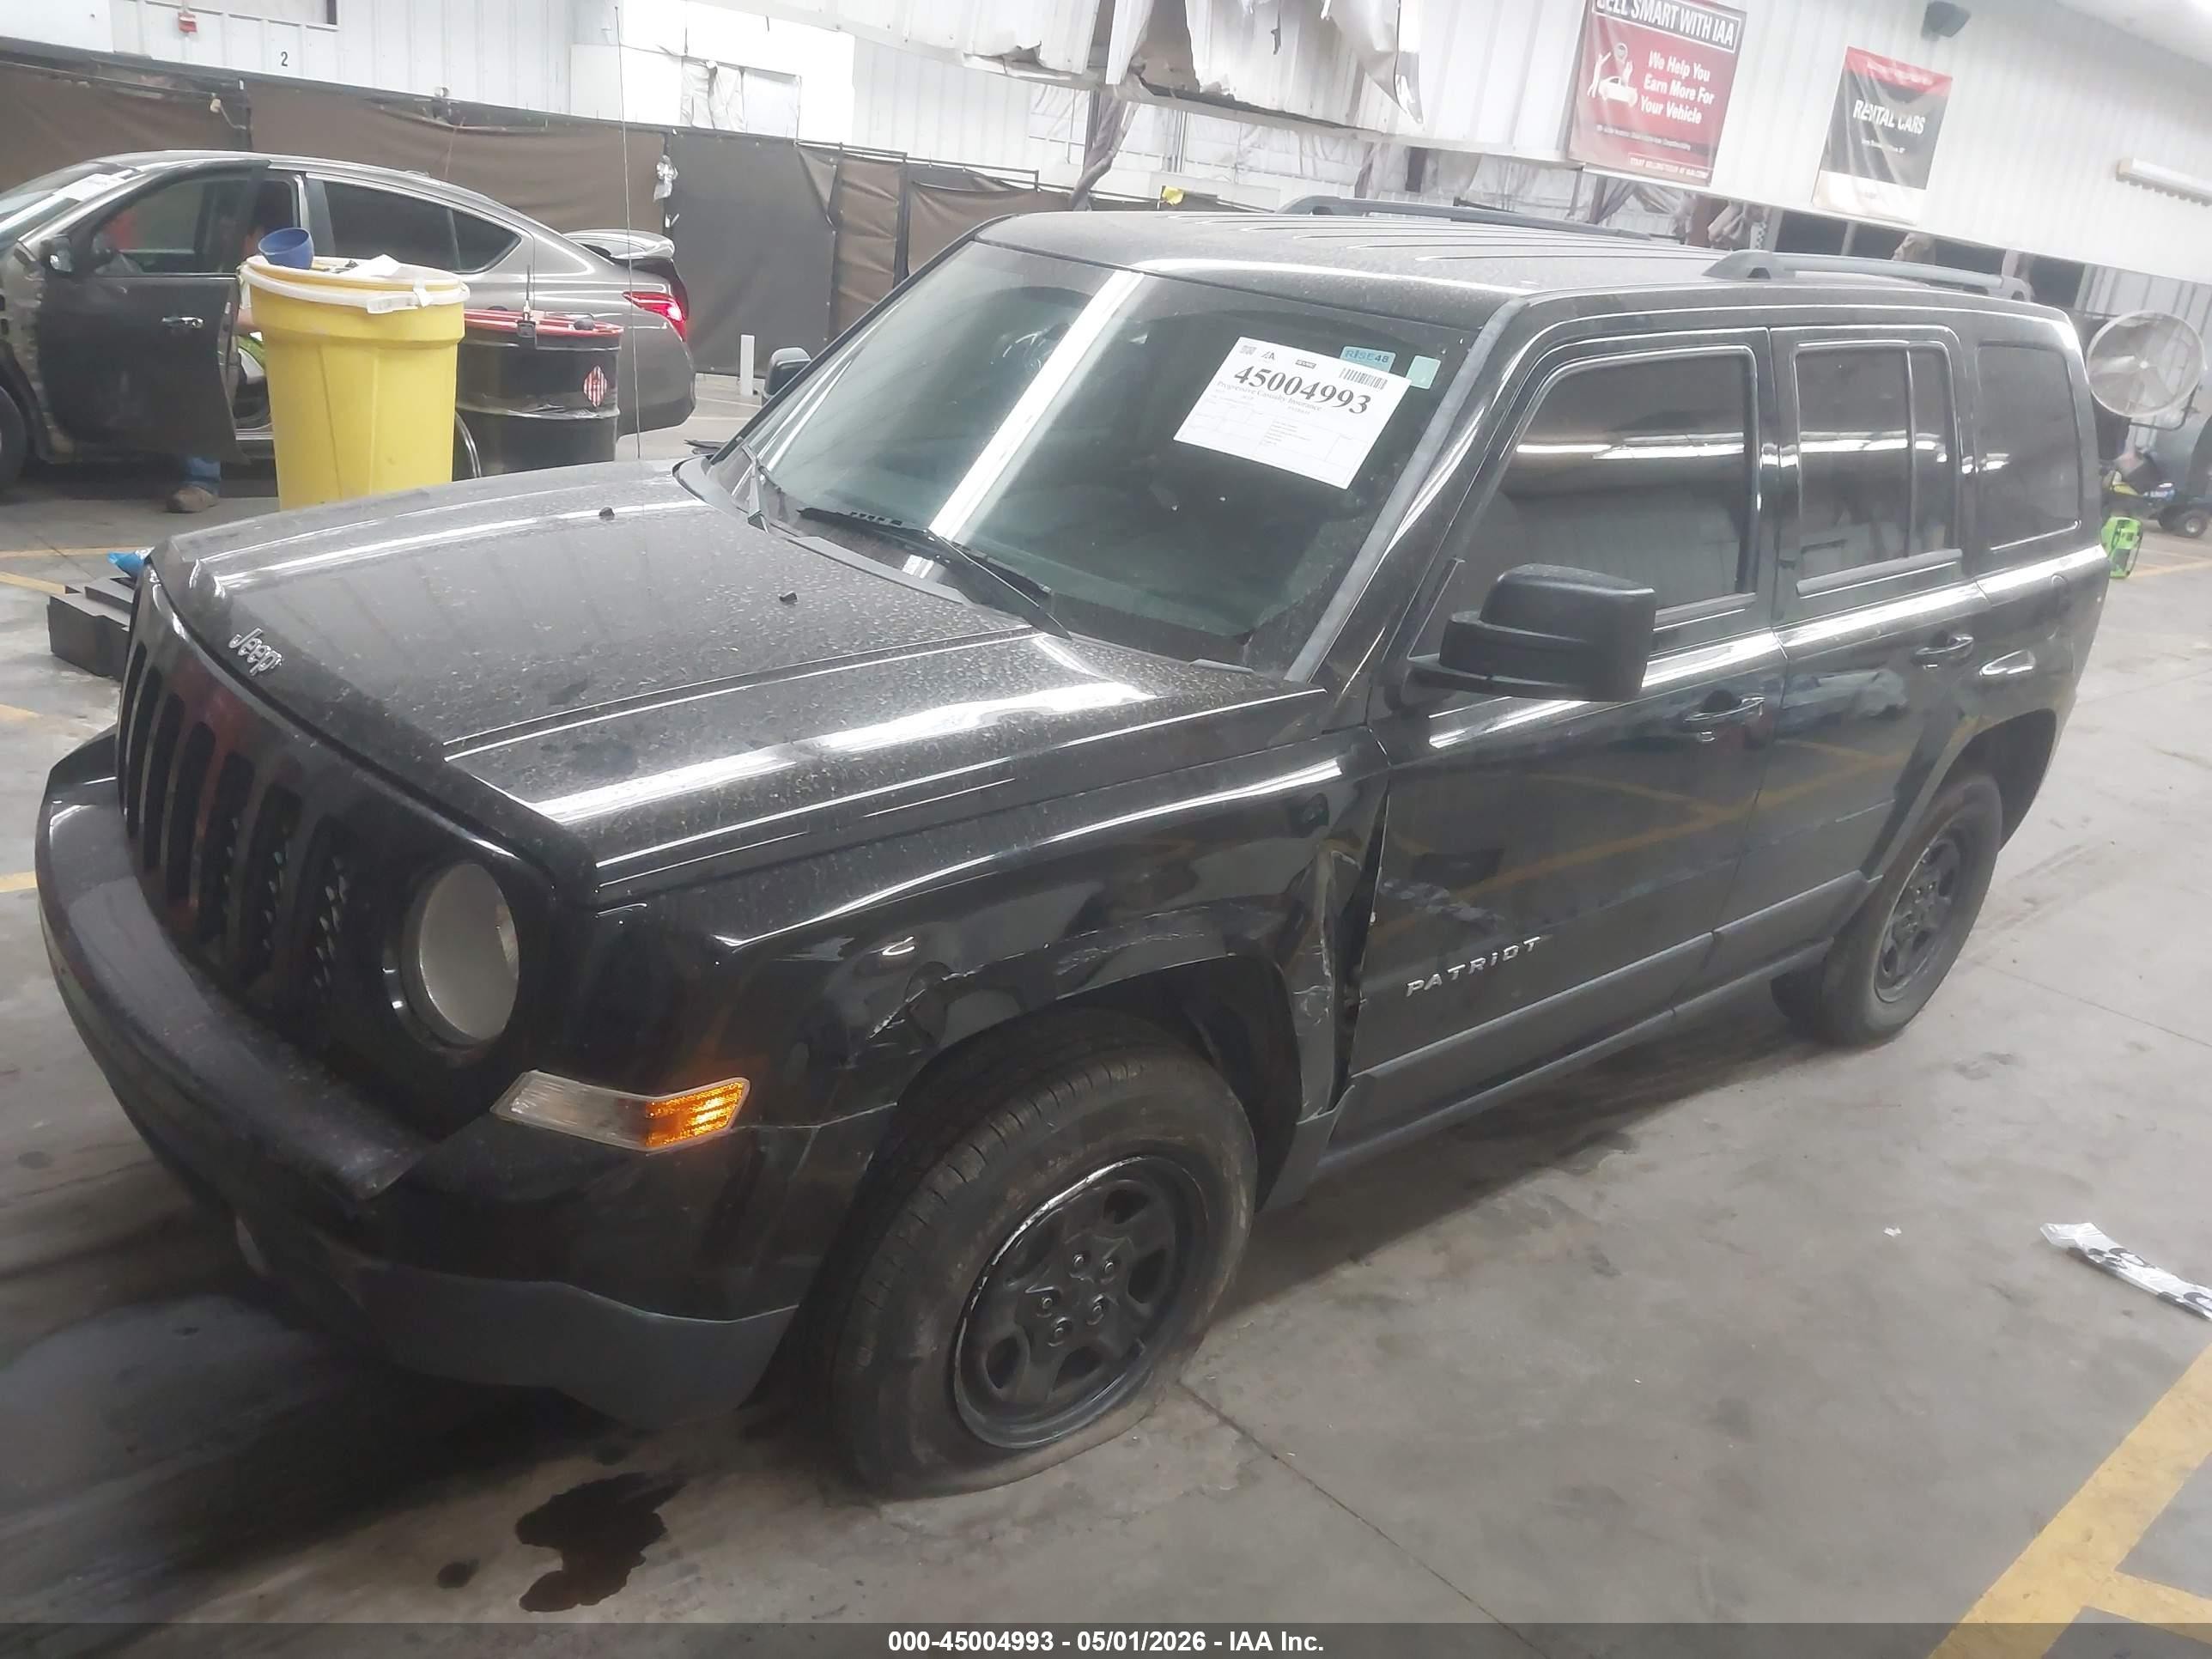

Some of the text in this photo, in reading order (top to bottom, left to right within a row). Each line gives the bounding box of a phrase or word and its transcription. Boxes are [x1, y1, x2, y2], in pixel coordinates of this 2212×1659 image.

[1632, 0, 1679, 29] SMART
[1679, 8, 1713, 39] WITH
[1712, 19, 1735, 46] IAA
[280, 51, 289, 67] 2
[1649, 50, 1711, 82] We Help You
[1644, 73, 1715, 105] Earn More For
[1641, 94, 1702, 125] Your Vehicle
[1853, 100, 1926, 135] RENTAL CARS
[1234, 366, 1372, 414] 45004993
[228, 628, 282, 676] Jeep
[1406, 936, 1541, 997] PATRIOT
